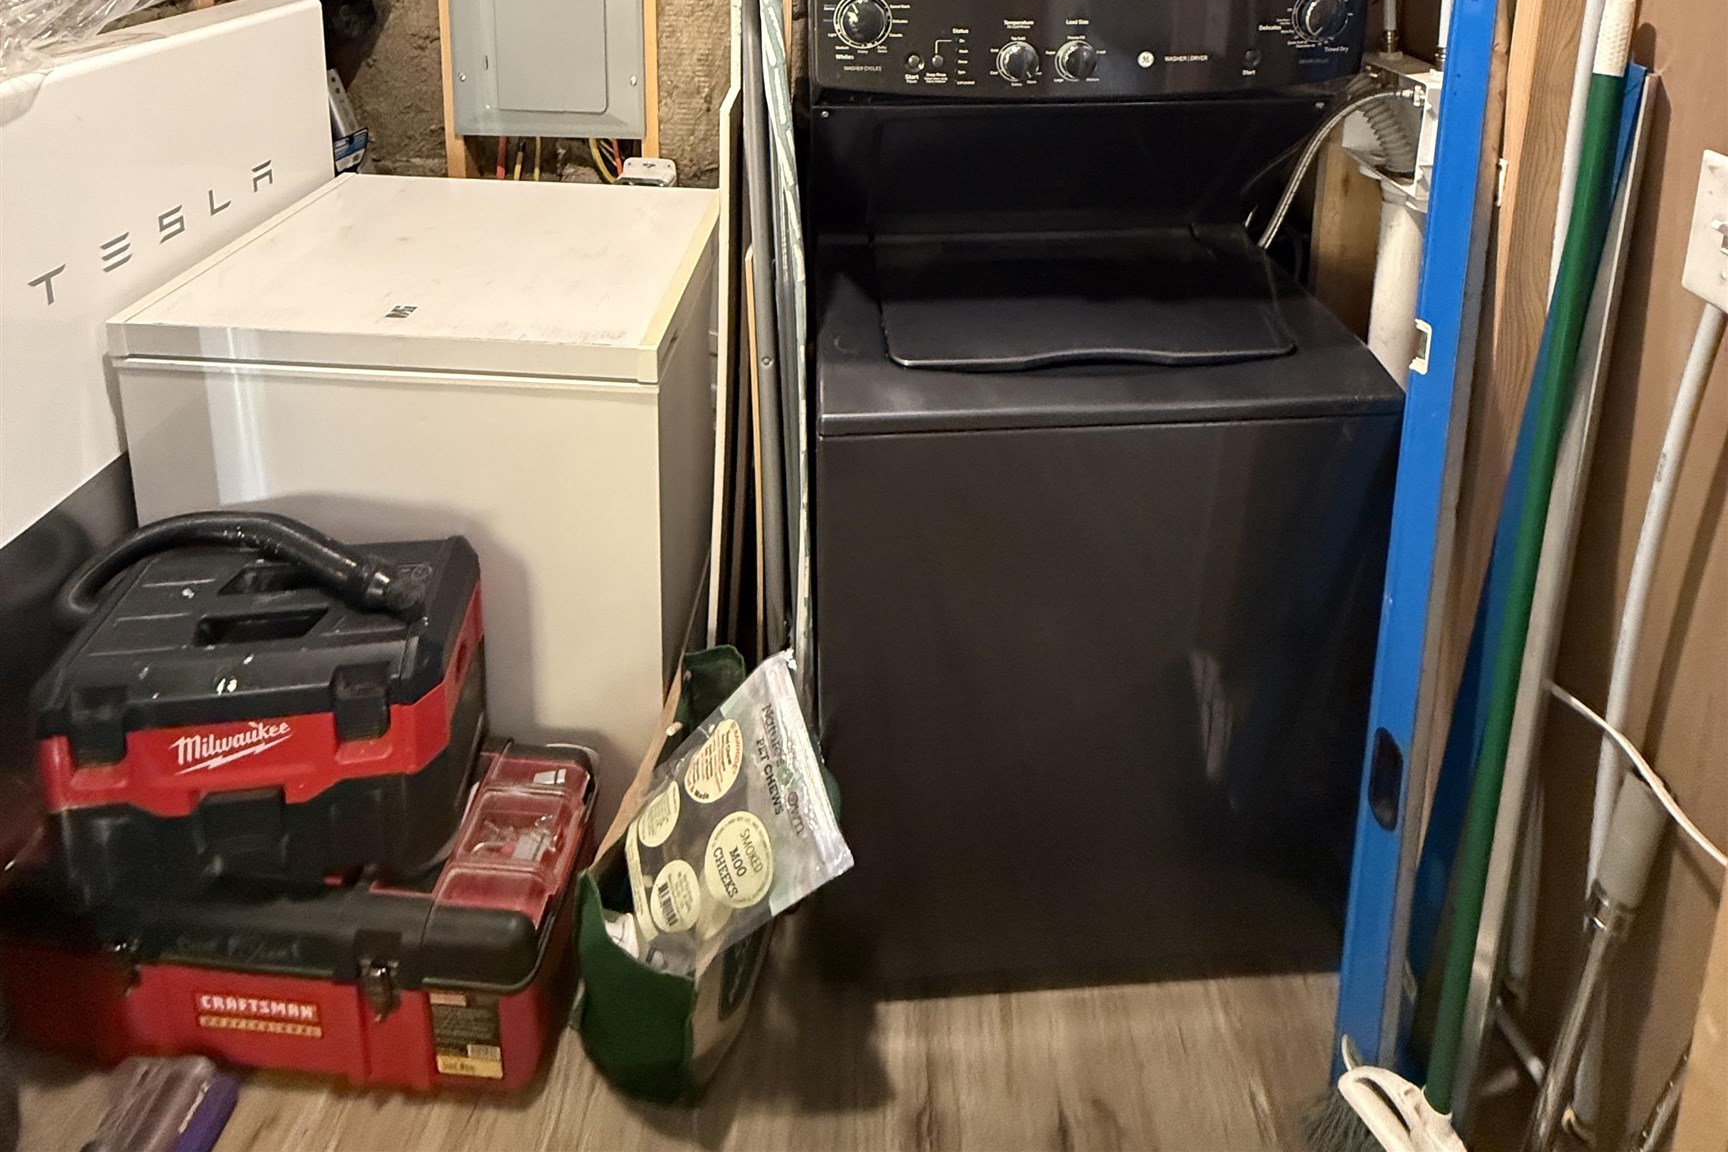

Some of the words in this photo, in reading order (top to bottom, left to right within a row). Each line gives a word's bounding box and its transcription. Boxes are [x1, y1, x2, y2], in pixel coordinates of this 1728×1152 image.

[28, 159, 273, 305] TESLA
[168, 721, 291, 765] Milwaukee
[756, 738, 769, 761] PET
[764, 764, 785, 816] CHEWS
[713, 847, 738, 898] CHEEKS
[729, 846, 747, 877] MOO
[740, 828, 764, 873] SMOKED
[200, 994, 314, 1020] CRAFTSMAN
